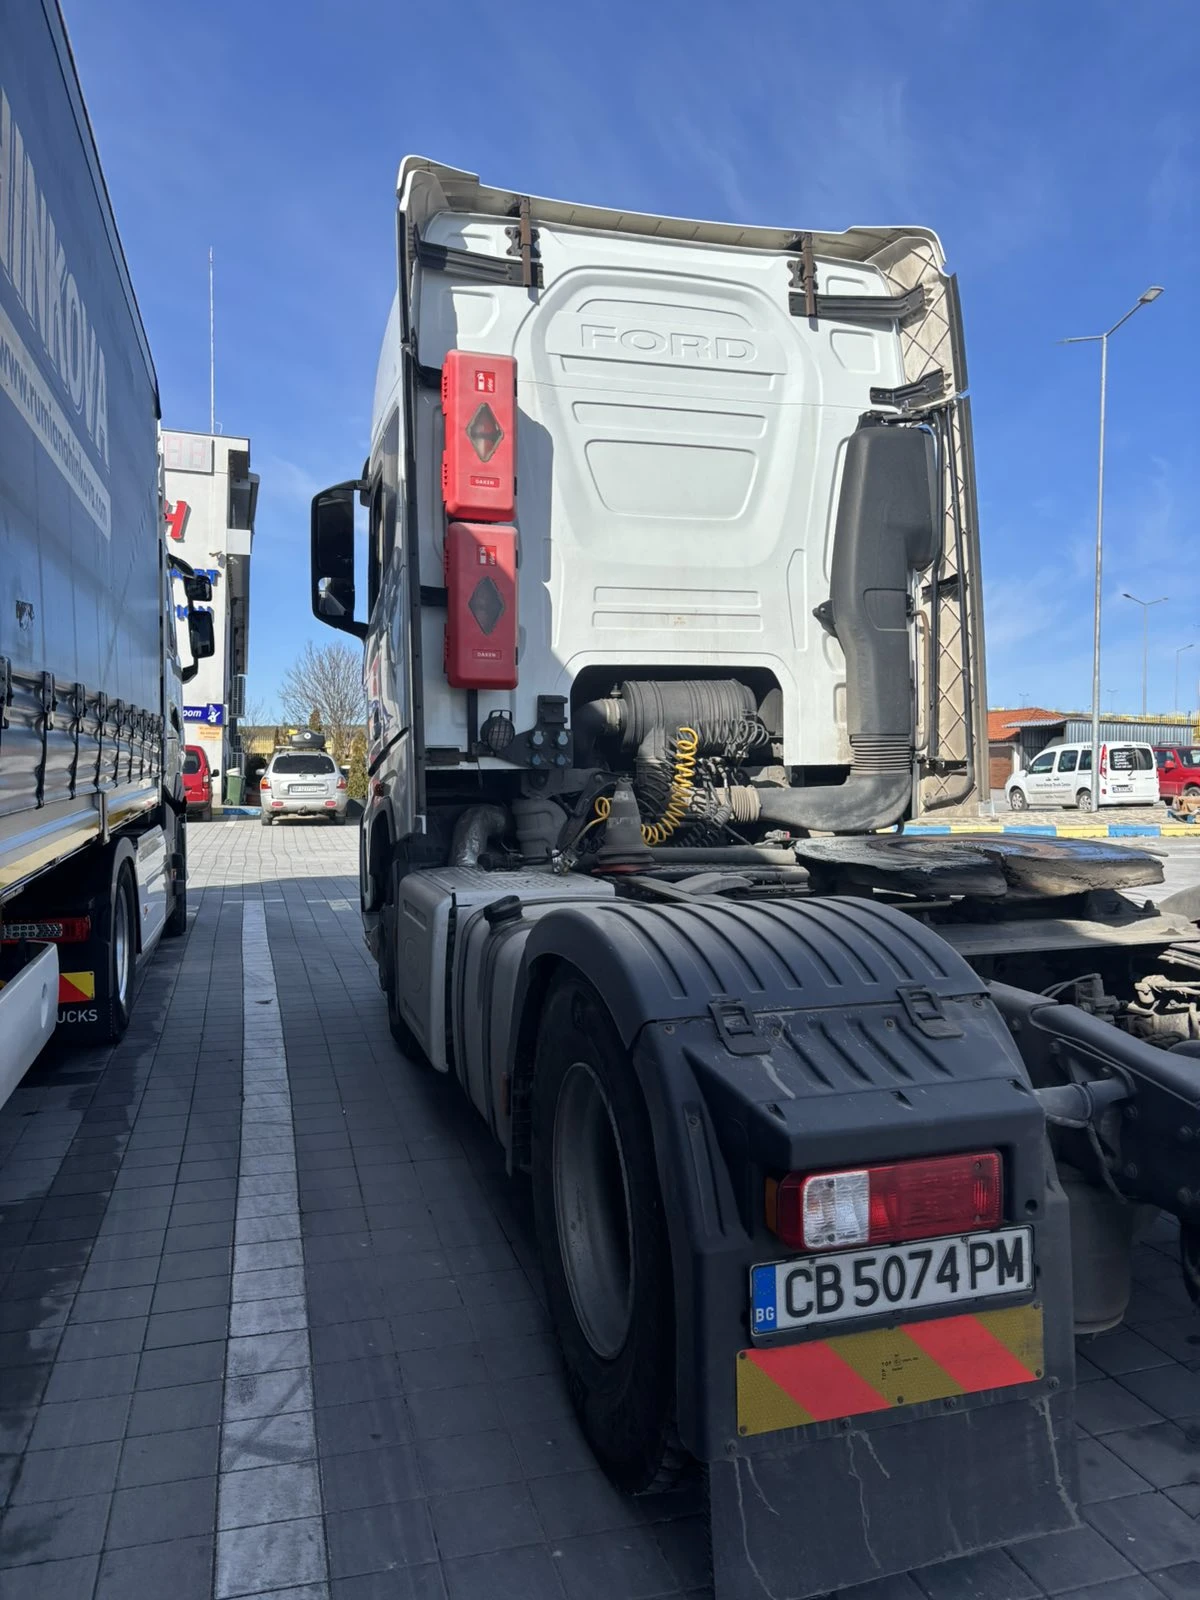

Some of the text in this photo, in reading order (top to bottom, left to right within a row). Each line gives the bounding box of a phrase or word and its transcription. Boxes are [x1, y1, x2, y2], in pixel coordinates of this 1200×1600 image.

[580, 323, 758, 363] FORD
[182, 709, 202, 718] oom
[56, 1009, 98, 1023] UCKS
[785, 1237, 1023, 1318] CB 5074 PM
[755, 1306, 775, 1322] BG
